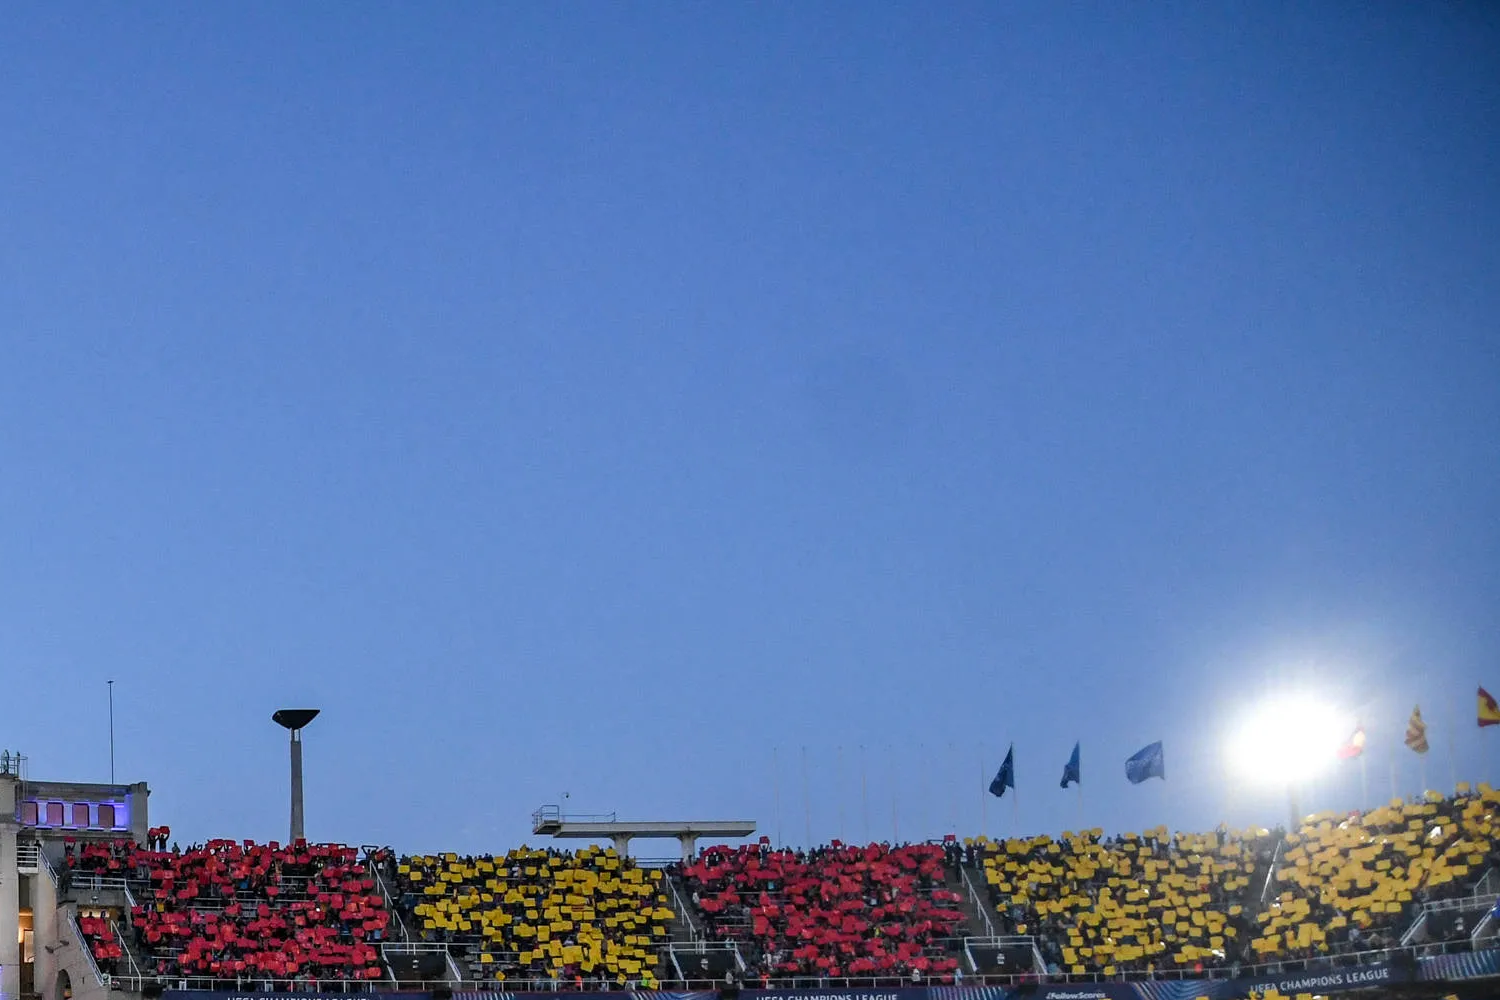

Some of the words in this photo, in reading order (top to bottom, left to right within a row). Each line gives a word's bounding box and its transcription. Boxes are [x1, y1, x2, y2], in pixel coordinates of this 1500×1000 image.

[1251, 983, 1277, 993] UEFA
[1280, 975, 1343, 991] CHAMPIONS
[1346, 968, 1389, 983] LEAGUE
